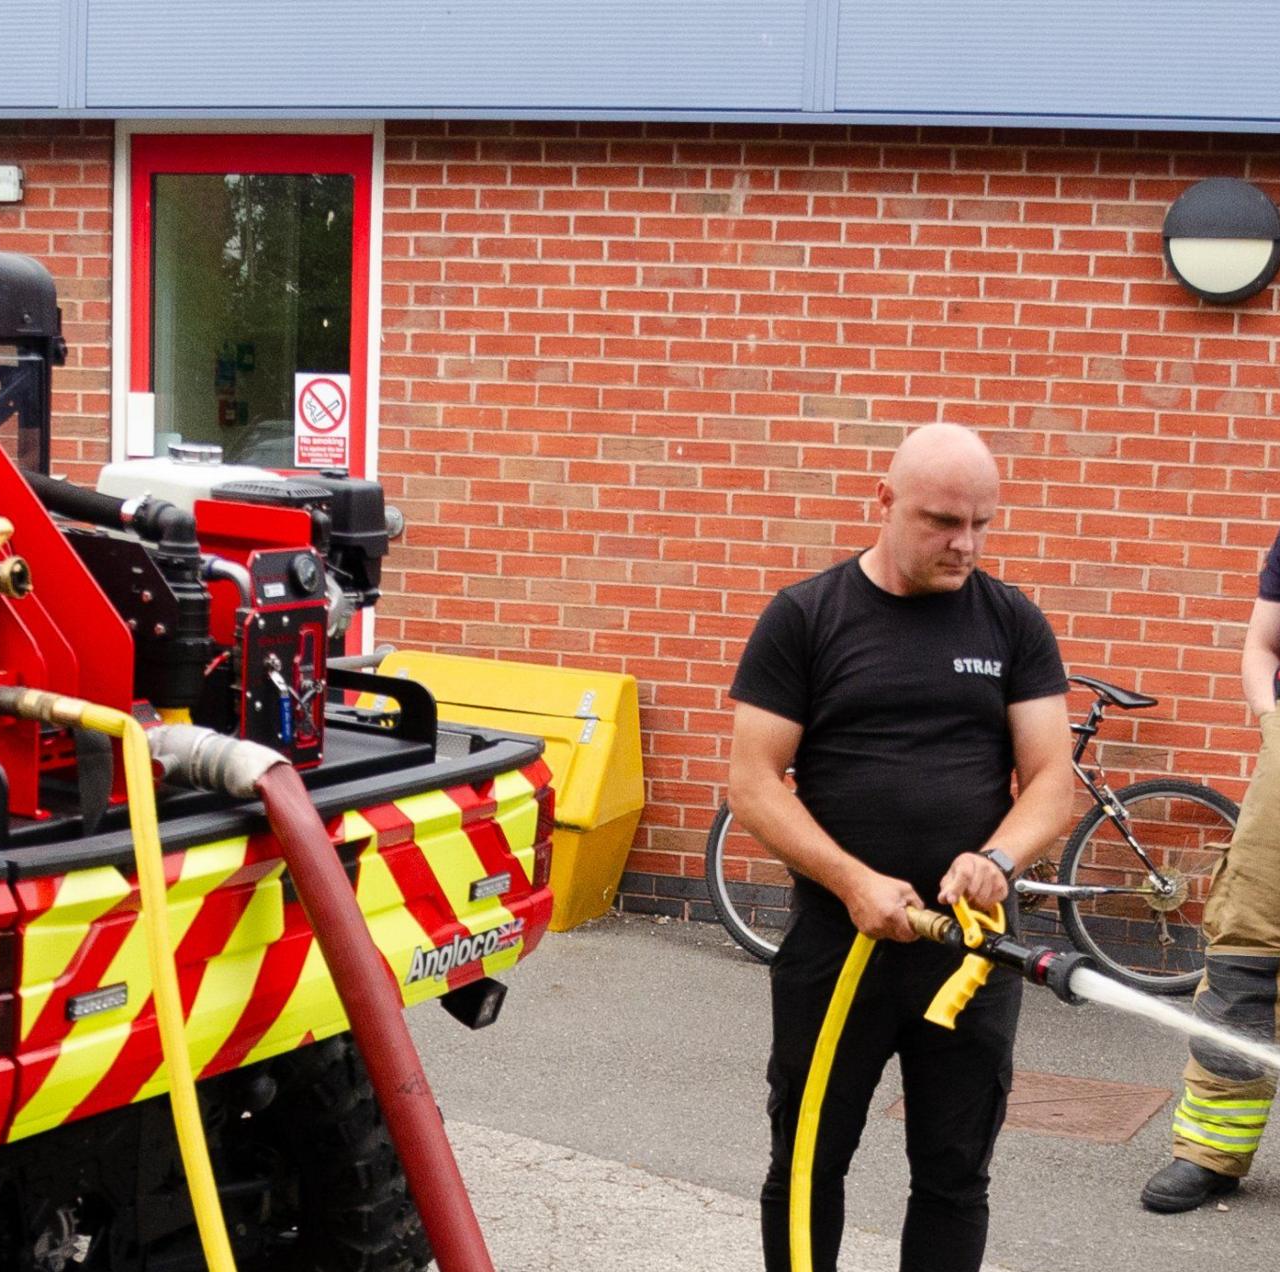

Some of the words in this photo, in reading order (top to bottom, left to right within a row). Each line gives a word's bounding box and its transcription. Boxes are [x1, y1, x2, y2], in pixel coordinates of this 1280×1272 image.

[300, 437, 311, 445] No
[312, 437, 345, 448] smoking
[404, 929, 498, 983] Angloco
